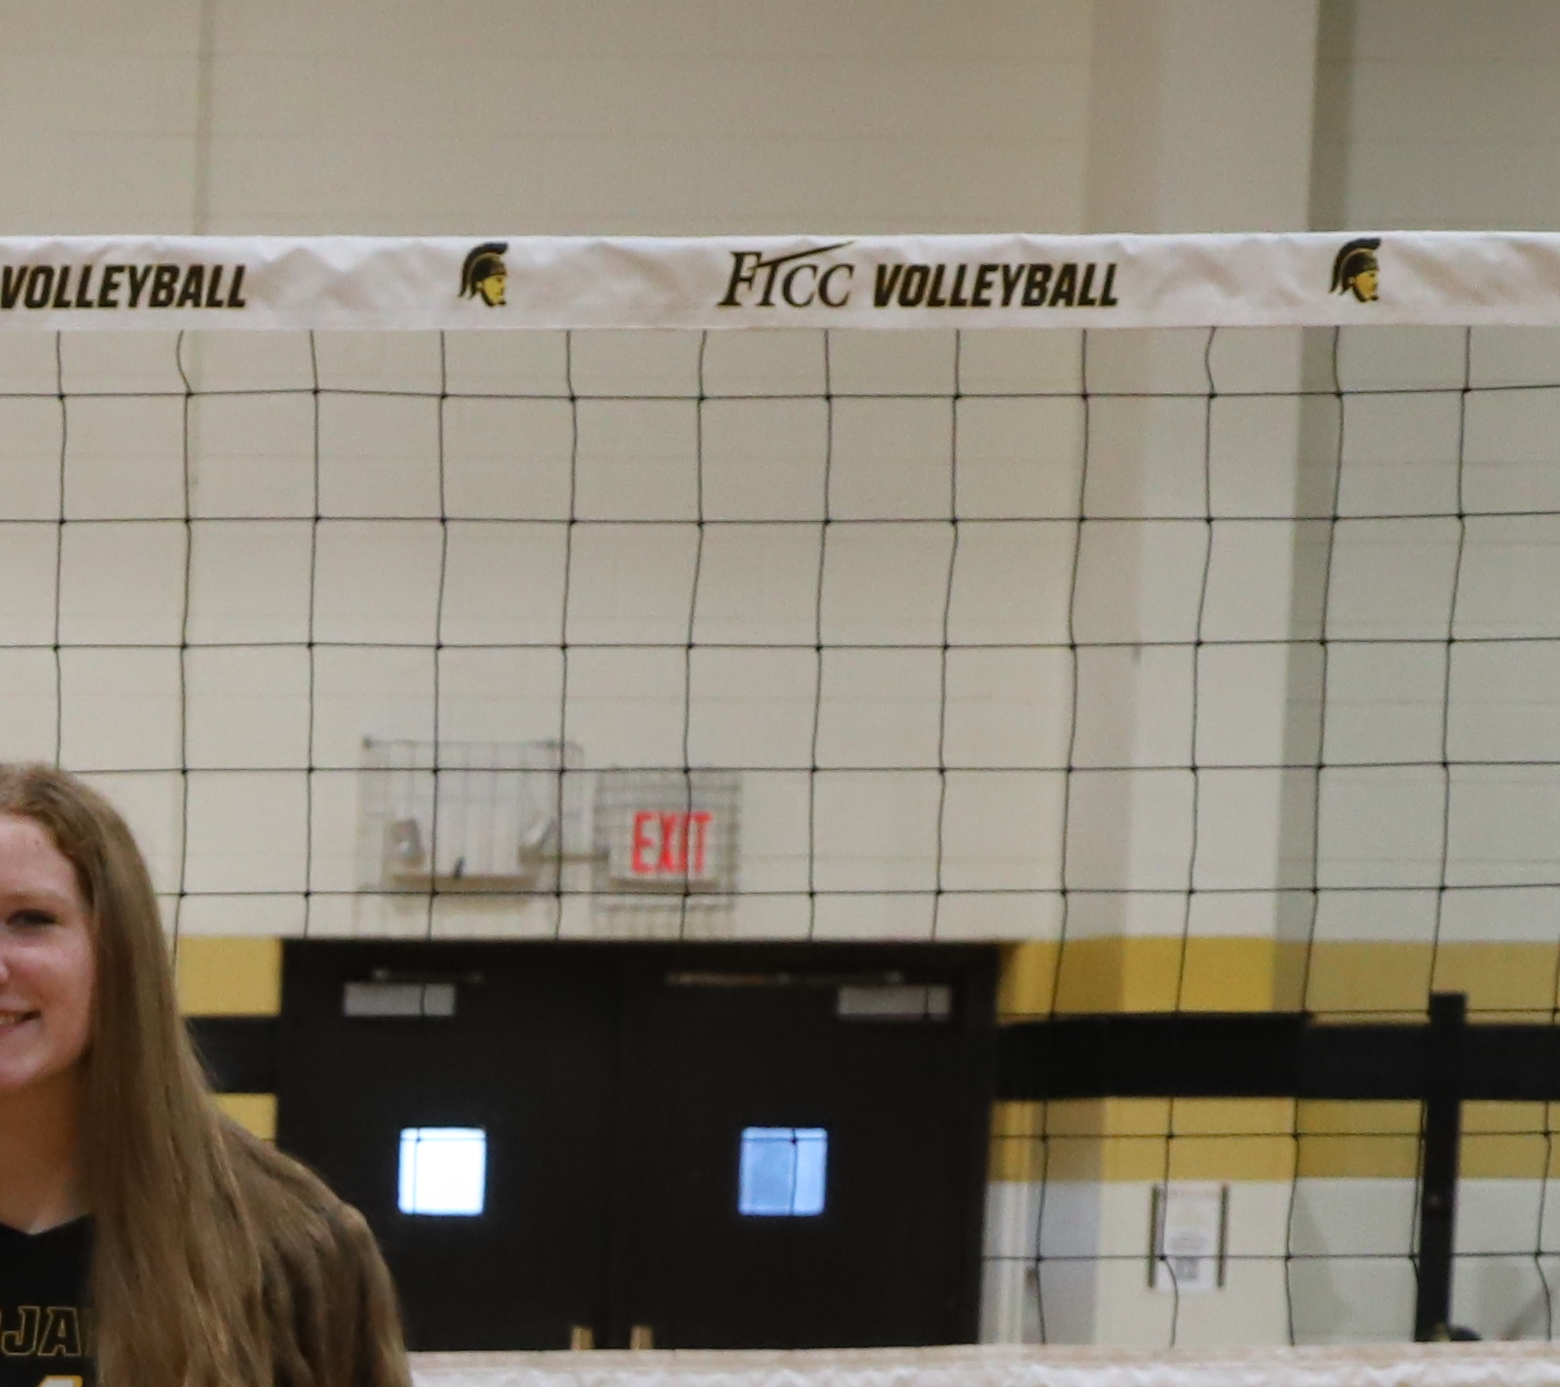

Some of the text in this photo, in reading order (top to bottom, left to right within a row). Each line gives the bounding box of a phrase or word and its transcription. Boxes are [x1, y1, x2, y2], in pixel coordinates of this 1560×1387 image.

[1, 264, 246, 310] VOLLEYBALL
[717, 244, 1118, 308] FTCC VOLLEYBALL
[631, 810, 712, 874] EXIT
